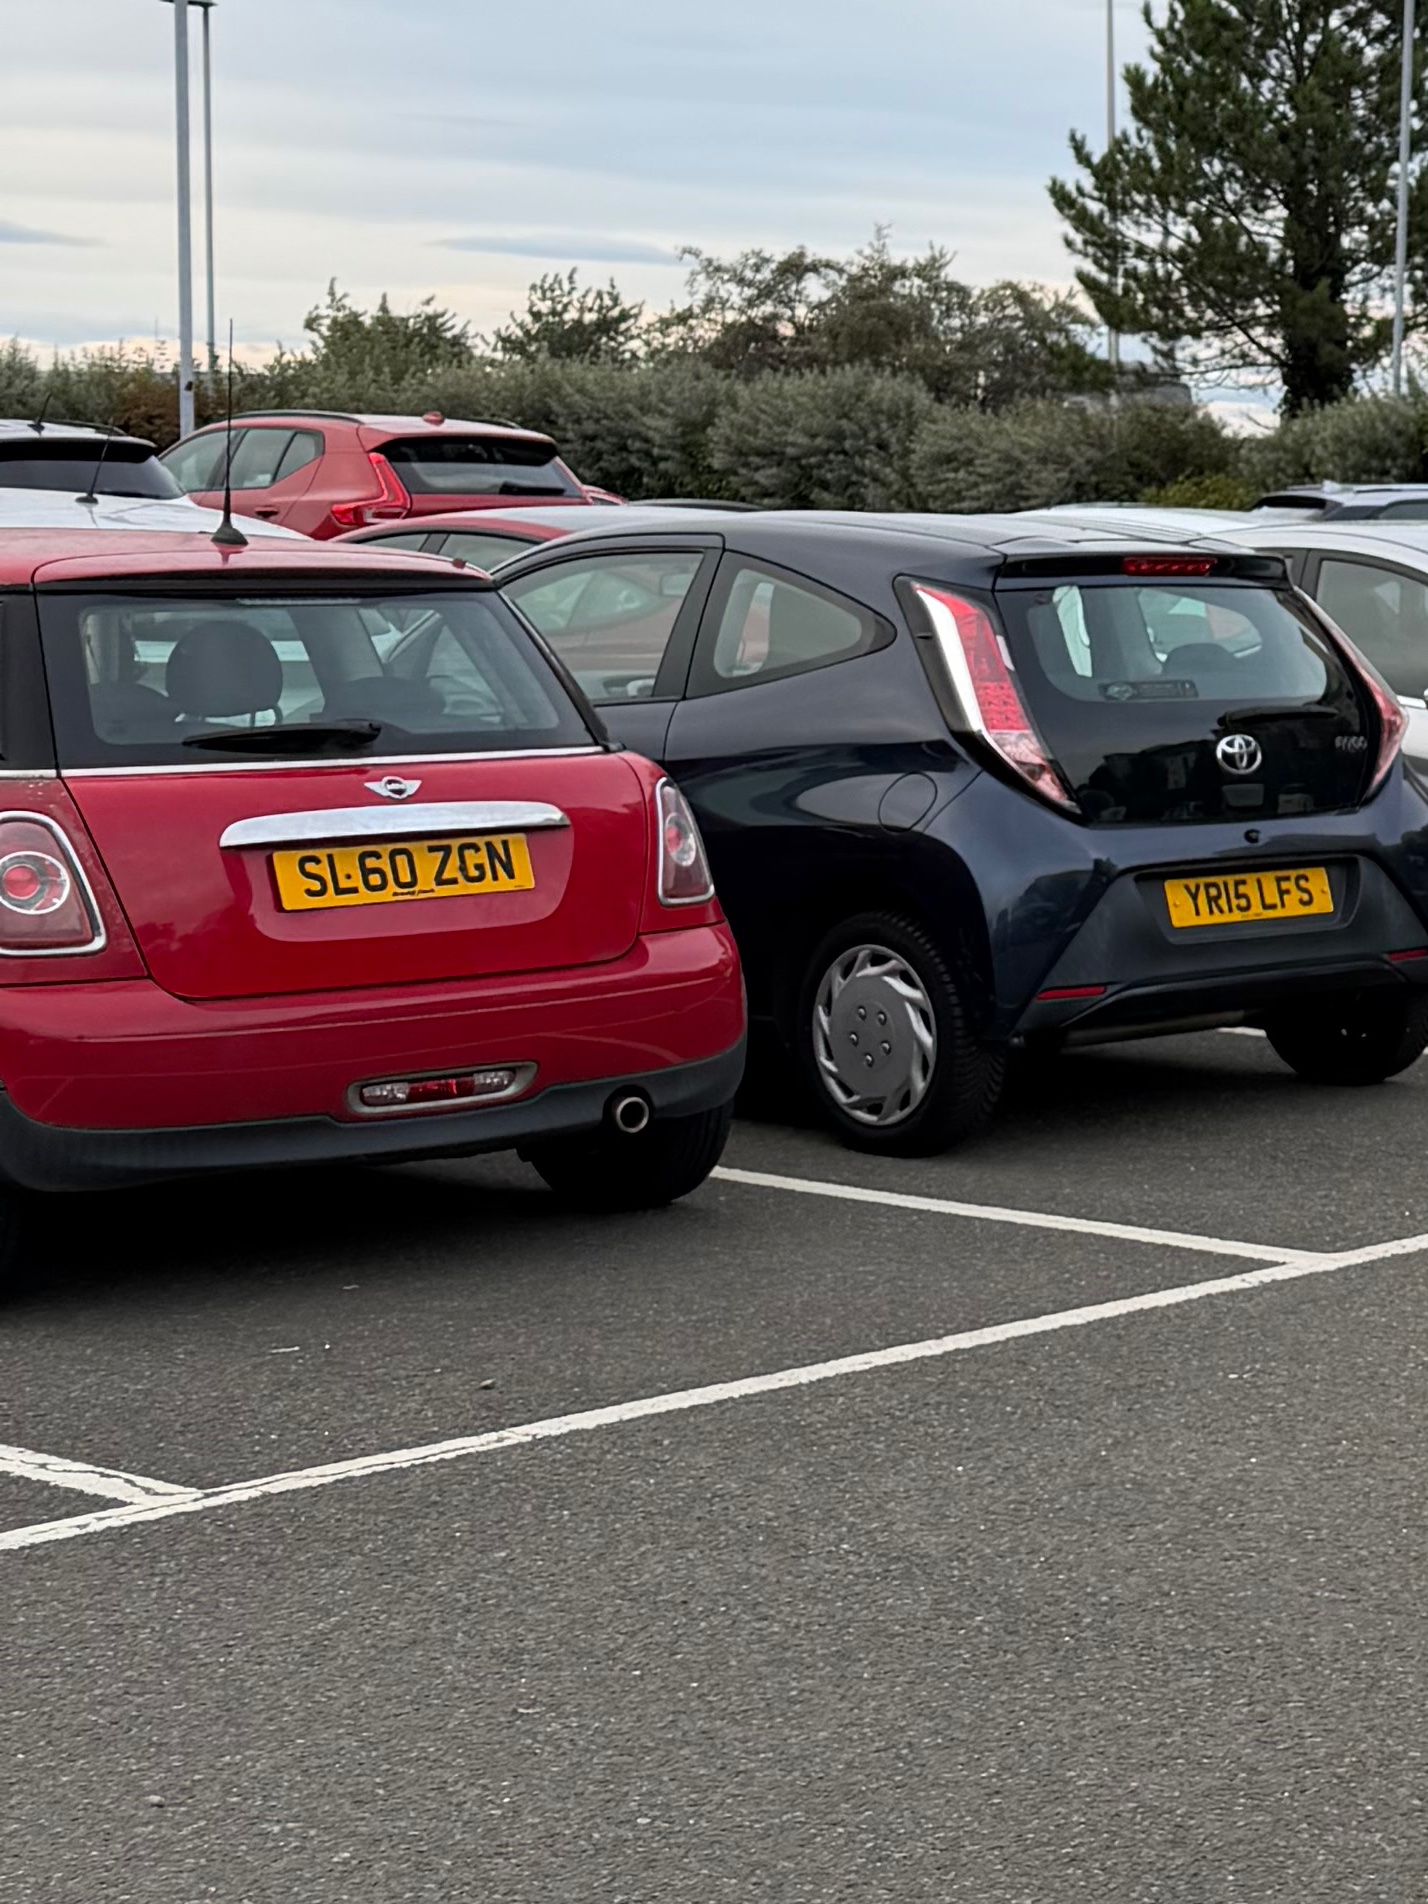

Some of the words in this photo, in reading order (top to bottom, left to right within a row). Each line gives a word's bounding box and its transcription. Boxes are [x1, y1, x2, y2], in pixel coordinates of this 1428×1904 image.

[297, 846, 419, 898] SL60
[426, 839, 516, 887] ZGN
[1183, 878, 1253, 917] YR15
[1256, 873, 1315, 914] LFS
